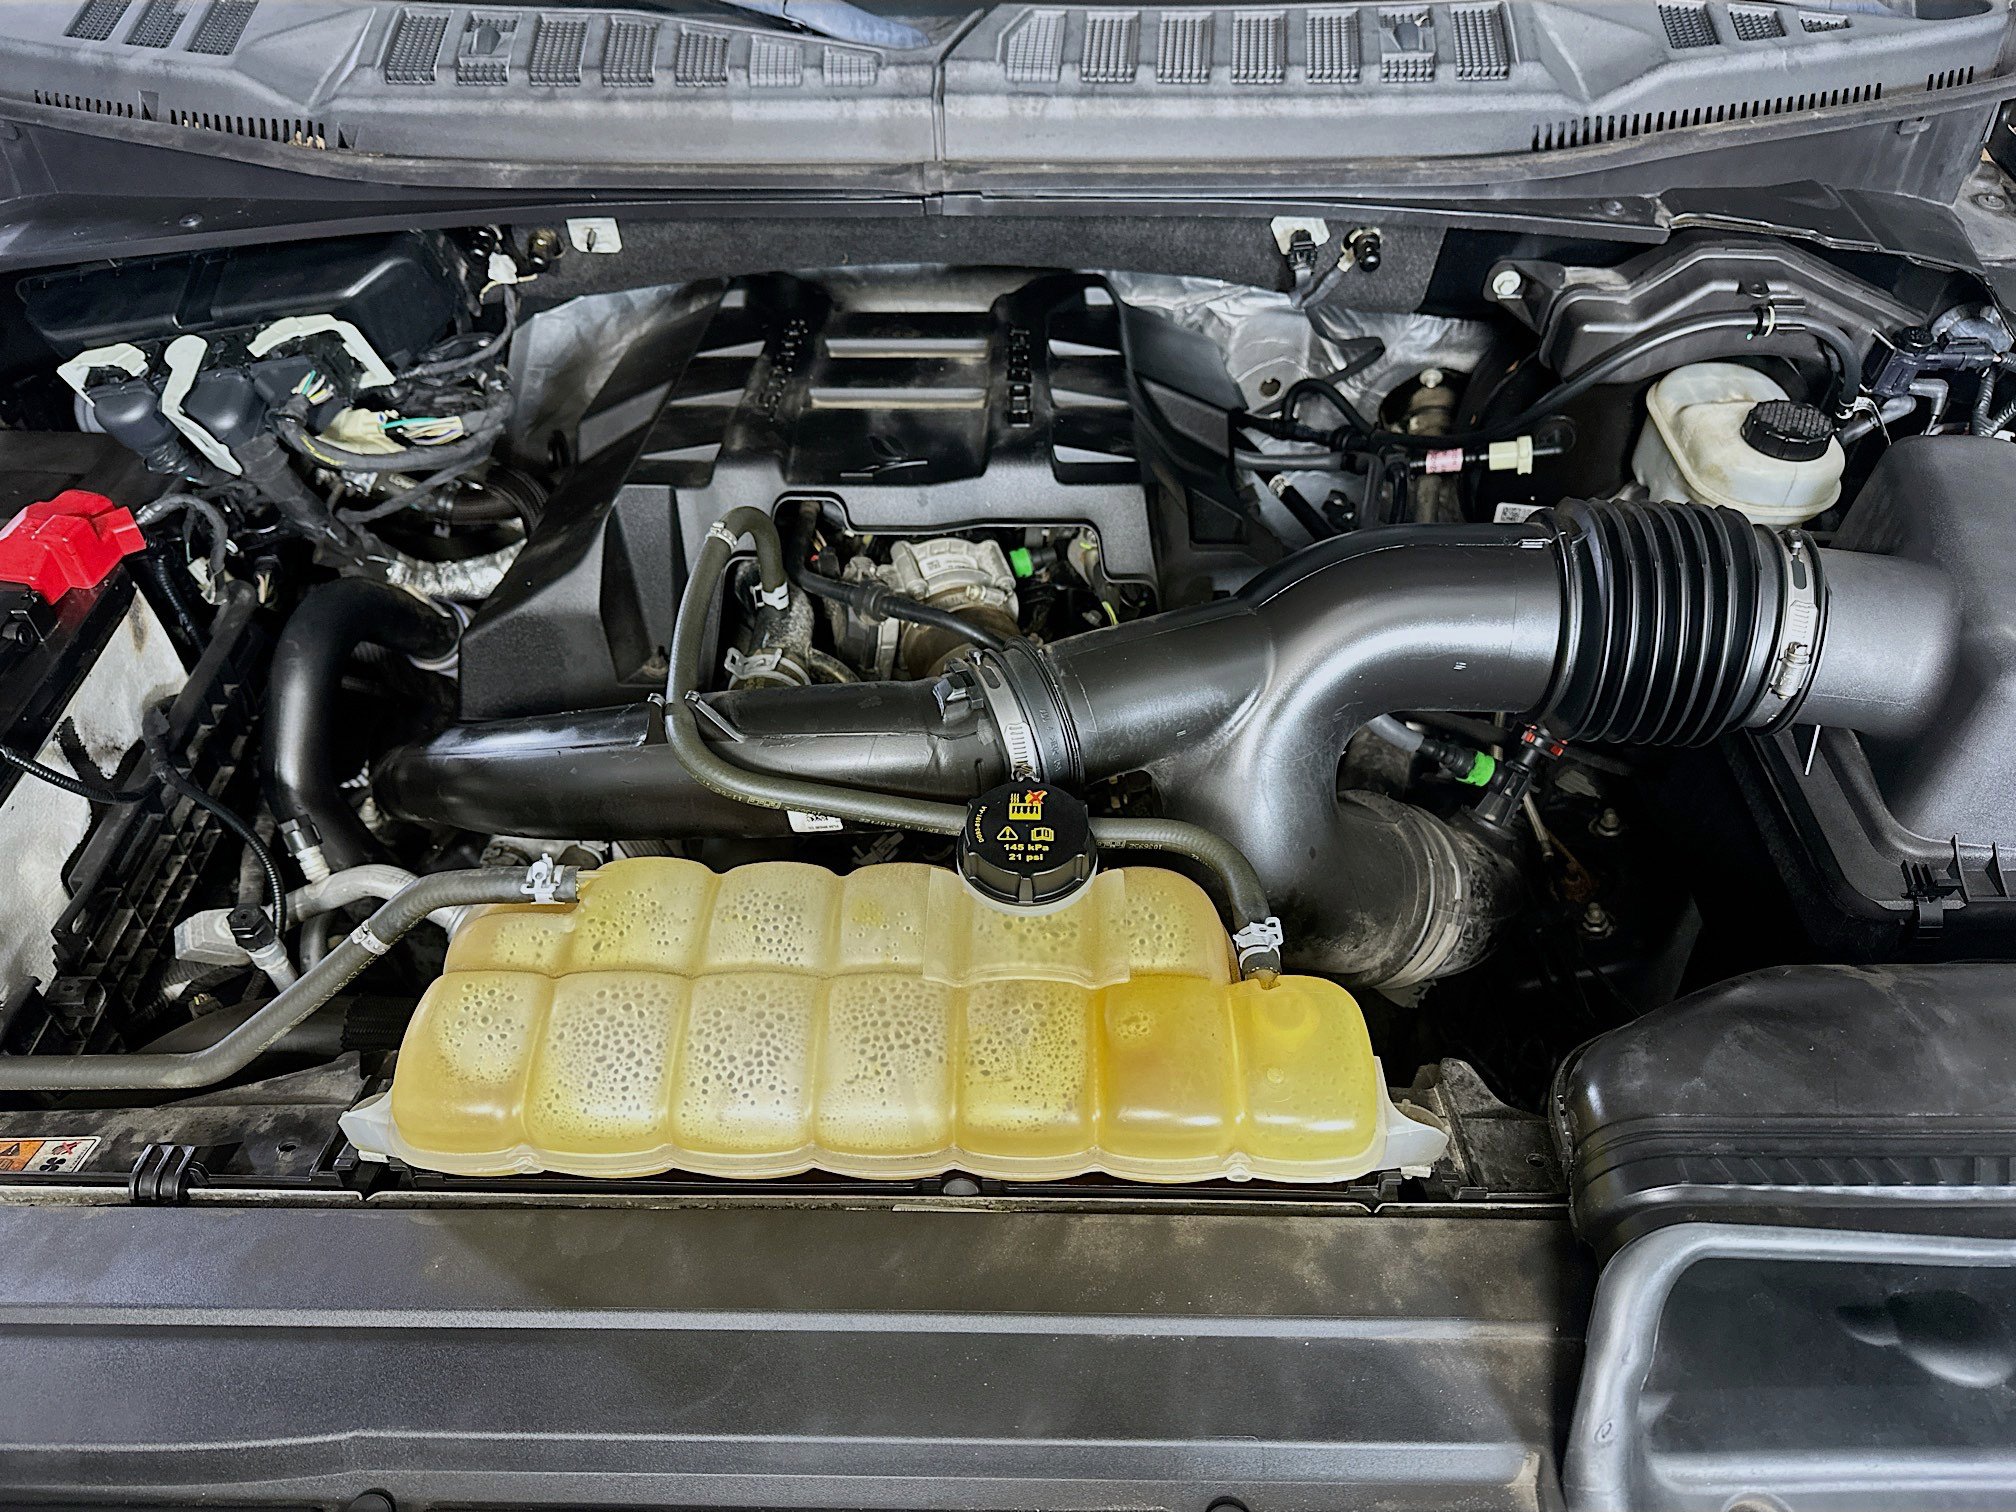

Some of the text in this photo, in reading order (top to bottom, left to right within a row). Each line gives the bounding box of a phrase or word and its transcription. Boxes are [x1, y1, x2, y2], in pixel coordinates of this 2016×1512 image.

[1003, 843, 1050, 851] 145 kPa
[1008, 853, 1044, 862] 21 psi
